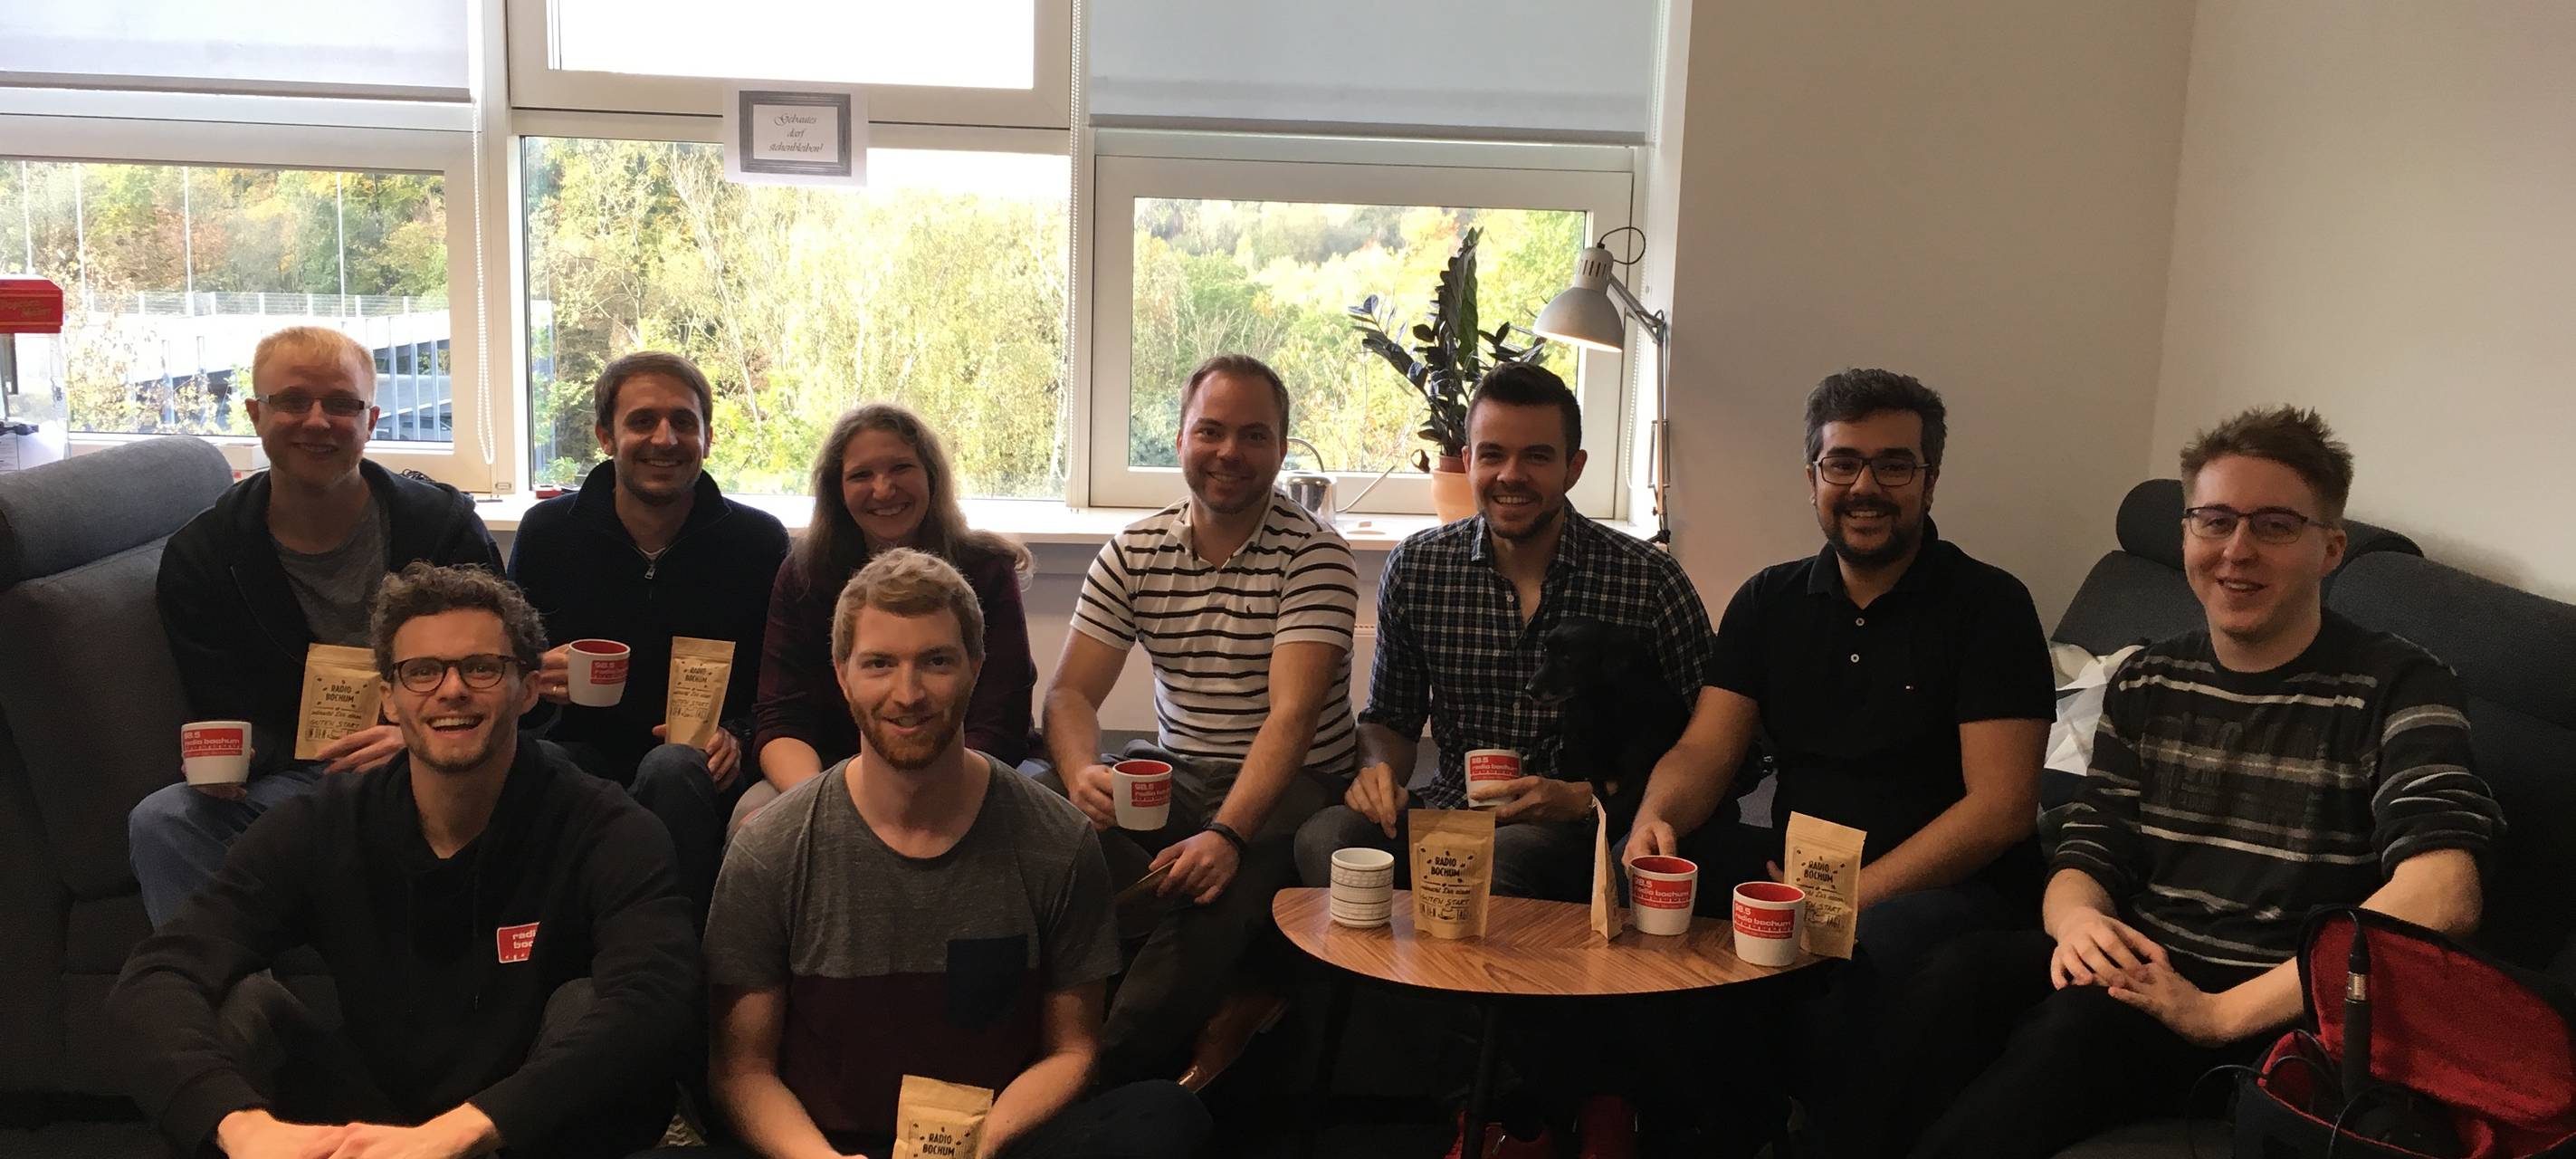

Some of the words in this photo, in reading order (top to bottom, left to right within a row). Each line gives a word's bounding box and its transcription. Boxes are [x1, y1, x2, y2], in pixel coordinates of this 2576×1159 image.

[787, 129, 806, 138] darf
[330, 685, 352, 694] RADIO
[325, 694, 354, 704] BOCHUM
[336, 720, 360, 729] START
[204, 737, 240, 745] bochum
[1435, 857, 1457, 867] RADIO
[1808, 860, 1830, 874] RADIO
[1430, 867, 1461, 877] BOCHUM
[1804, 869, 1834, 883] BOCHUM
[1655, 889, 1689, 897] bochum
[1445, 898, 1471, 906] START
[1818, 904, 1842, 914] START
[1753, 917, 1791, 927] bochum
[512, 929, 536, 940] radi
[928, 1133, 952, 1145] RADIO
[922, 1144, 955, 1156] BOCHUM
